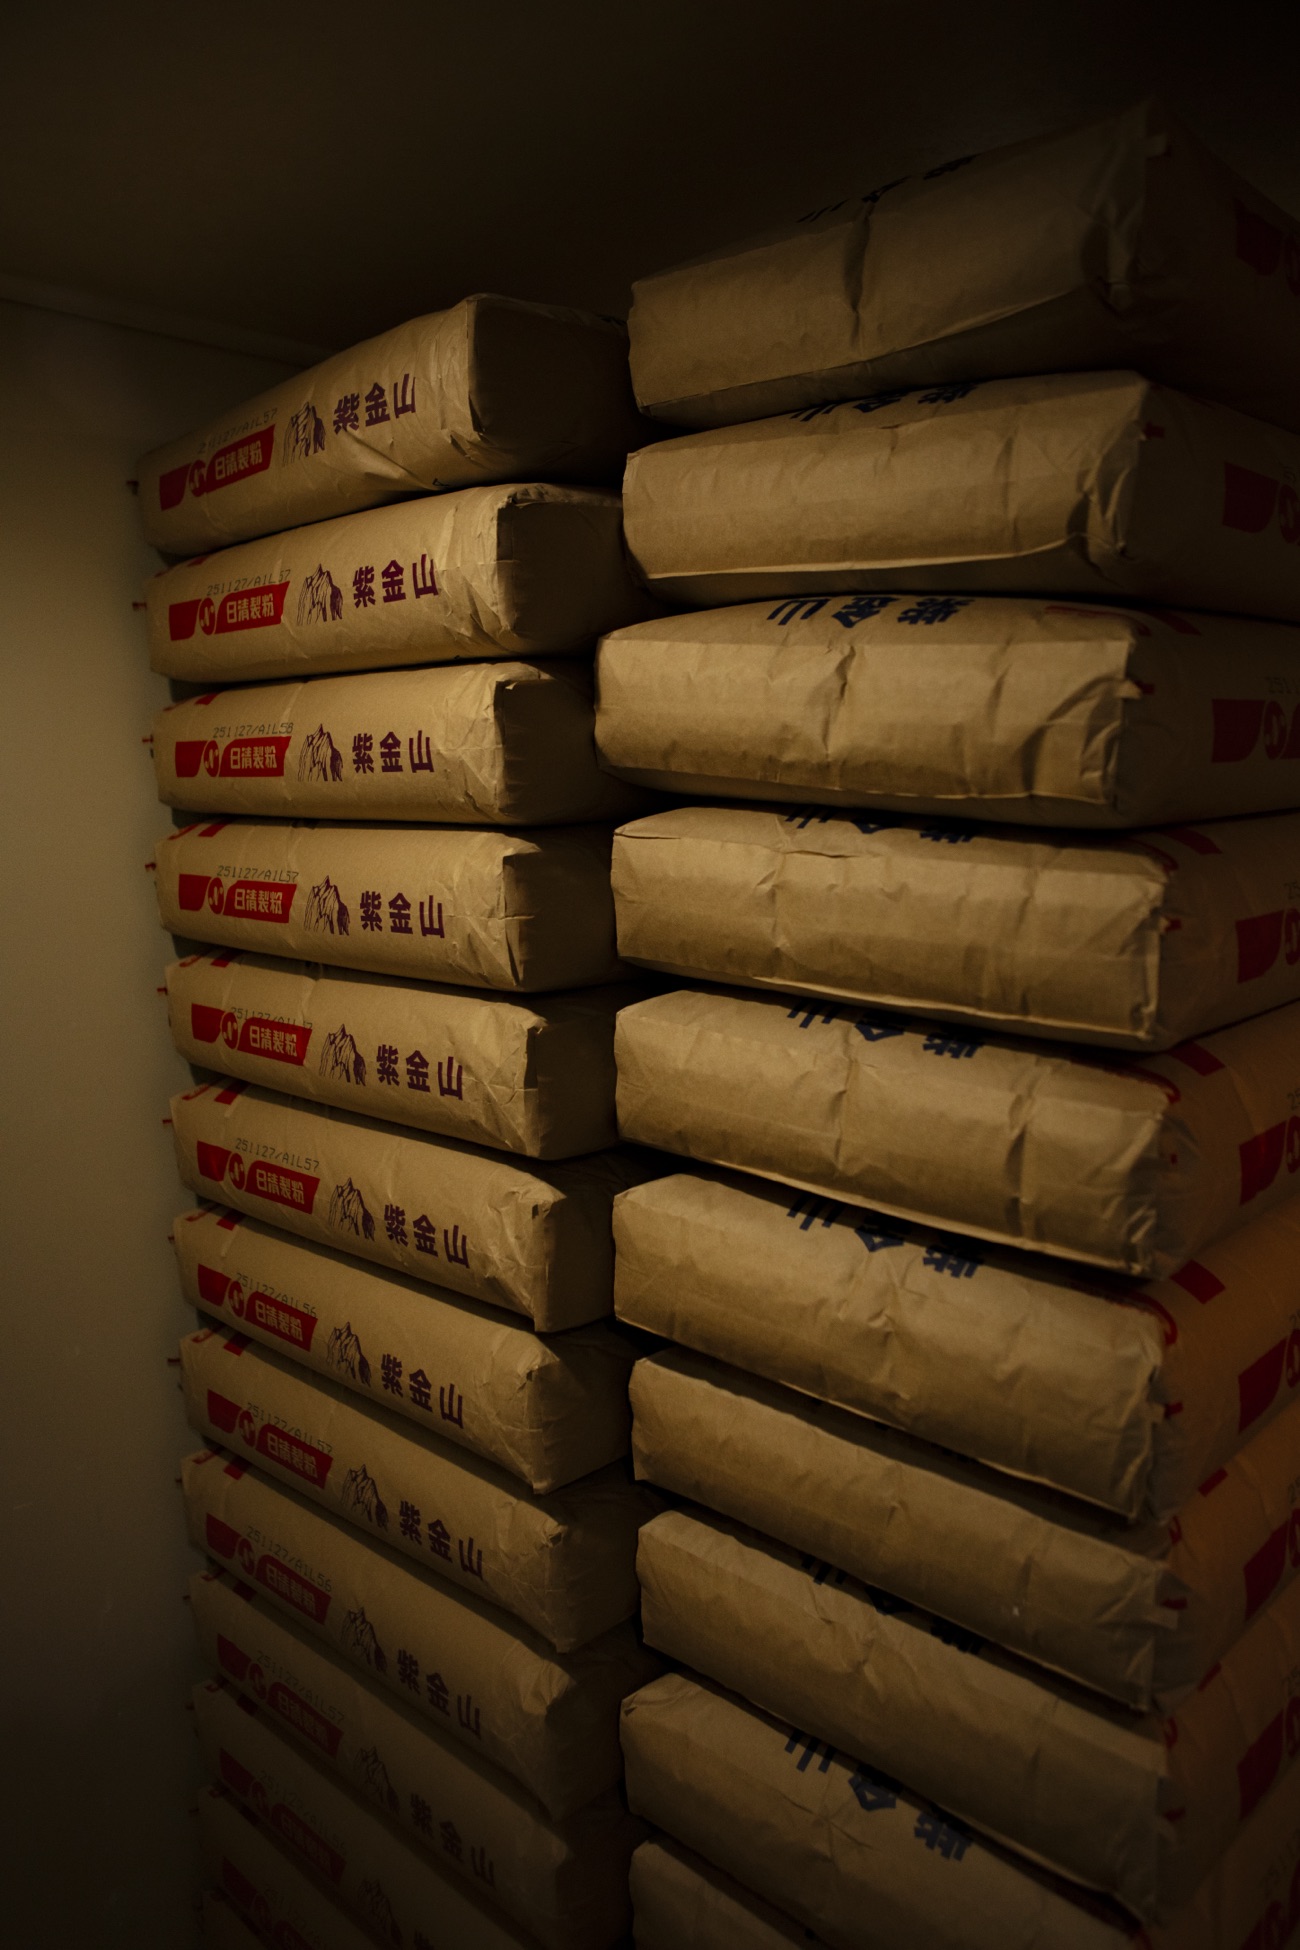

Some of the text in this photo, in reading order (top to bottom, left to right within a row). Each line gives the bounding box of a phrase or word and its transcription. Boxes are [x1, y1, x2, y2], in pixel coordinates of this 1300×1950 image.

[333, 373, 416, 434] 紫金山
[214, 443, 263, 481] 日清製粉
[353, 554, 439, 608] 紫金山
[226, 593, 275, 622] 日清製粉
[229, 746, 277, 770] 日清製粉
[352, 730, 435, 774] 紫金山
[234, 888, 283, 915] 日清製粉
[360, 891, 445, 938] 紫金山
[249, 1025, 298, 1058] 日清製粉
[377, 1045, 464, 1100] 紫金山
[256, 1168, 306, 1205] 日清製粉
[384, 1204, 468, 1268] 紫金山
[254, 1300, 304, 1342] 日清製粉
[381, 1354, 464, 1429] 紫金山
[400, 1500, 484, 1581] 紫金山
[398, 1649, 482, 1740] 紫金山
